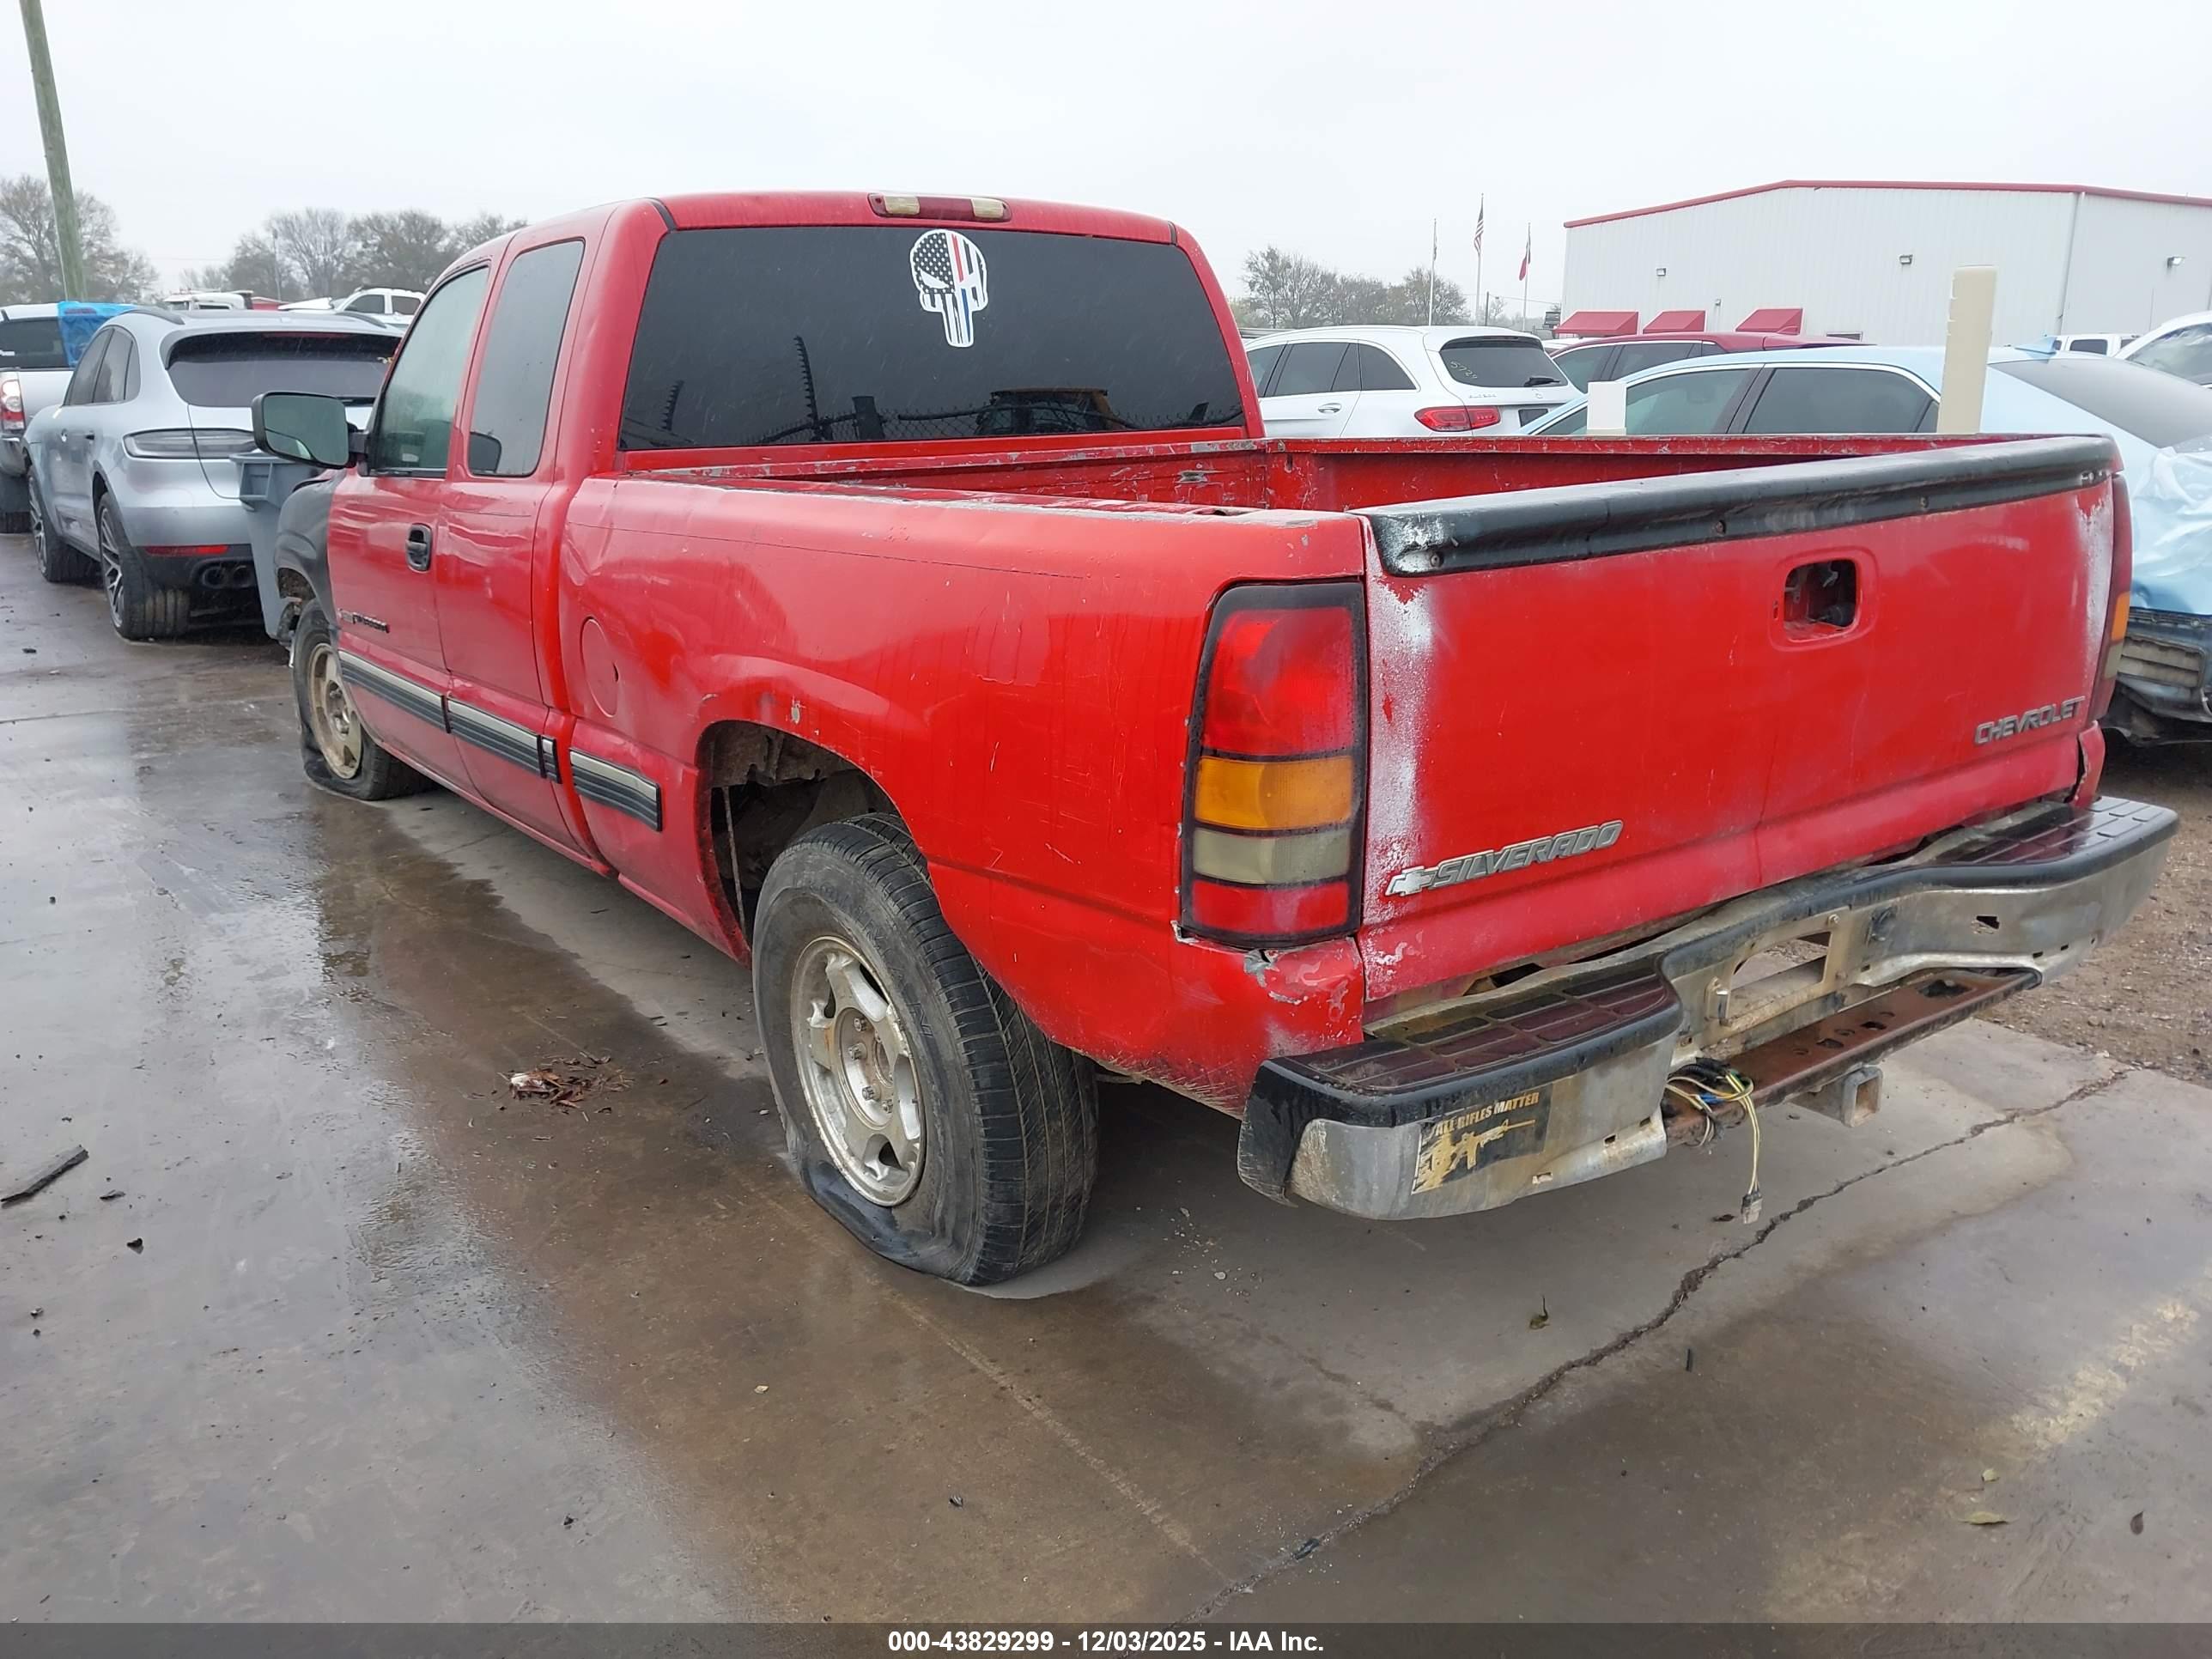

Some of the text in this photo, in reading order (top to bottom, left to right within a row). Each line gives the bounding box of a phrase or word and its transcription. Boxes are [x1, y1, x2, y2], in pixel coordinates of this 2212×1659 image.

[1974, 695, 2087, 744] CHEVROLET
[1431, 819, 1625, 889] SILVERADO
[1457, 1105, 1493, 1130] RIFLES
[1494, 1091, 1540, 1115] MATTER
